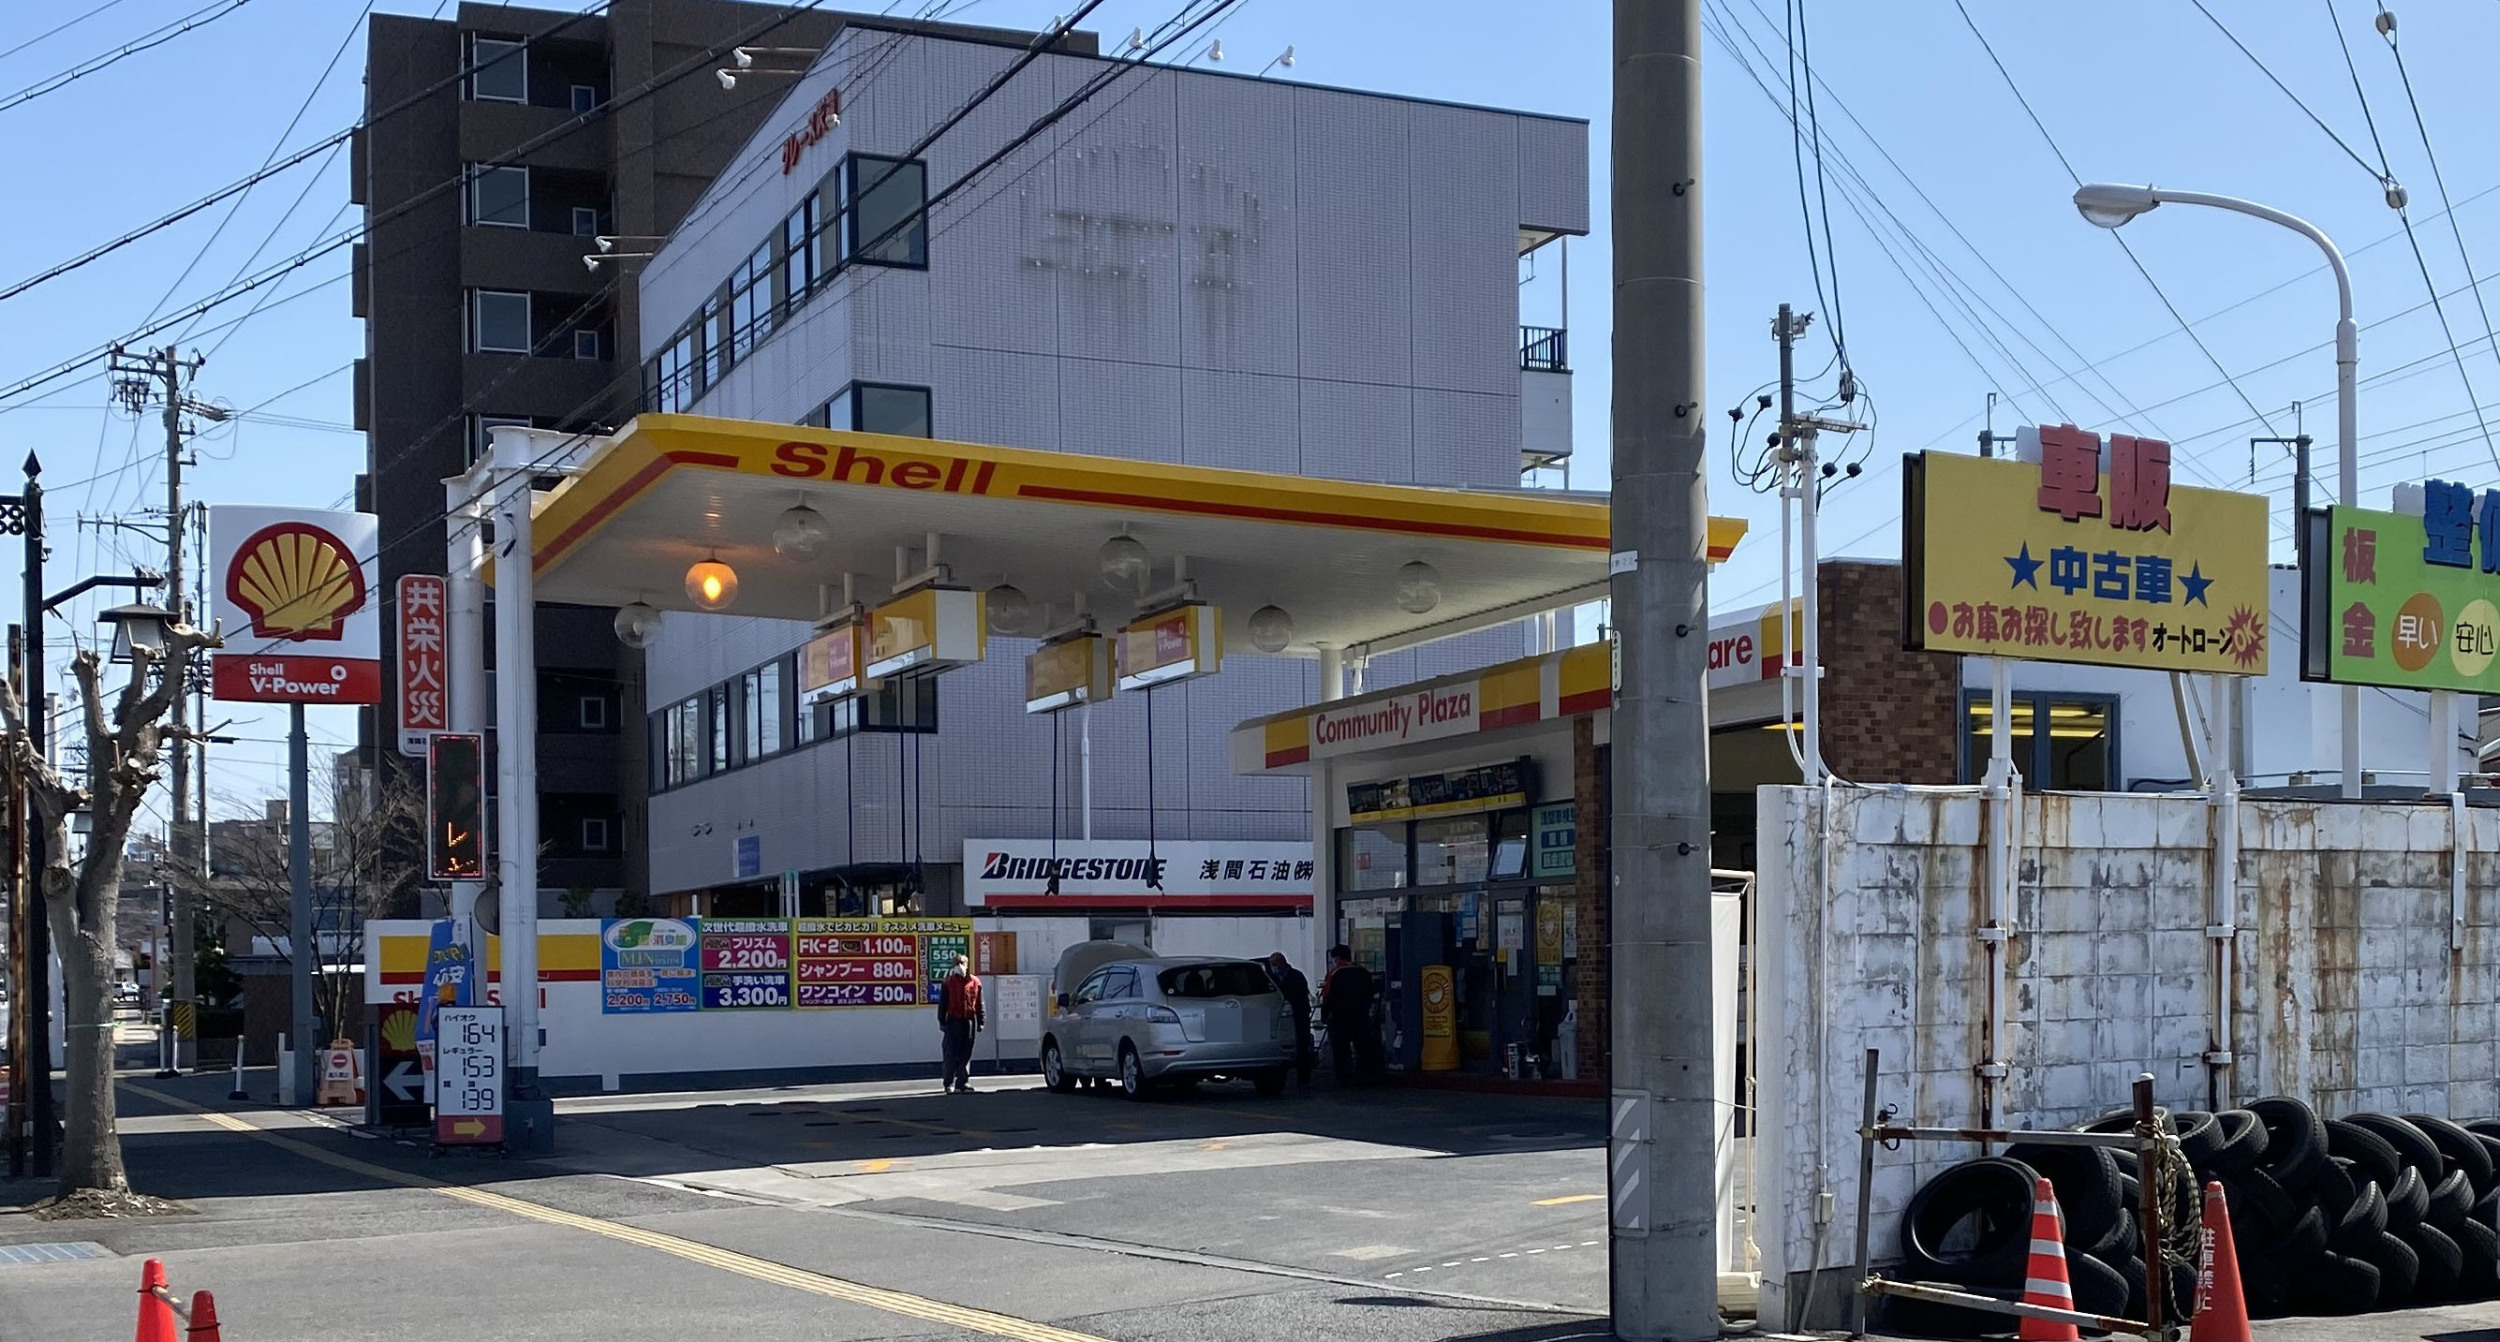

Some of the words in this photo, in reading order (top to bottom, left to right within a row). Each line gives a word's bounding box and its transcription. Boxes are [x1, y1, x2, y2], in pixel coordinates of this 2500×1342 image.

[770, 441, 997, 495] Shell
[2039, 423, 2172, 533] 車販
[2050, 546, 2172, 604] 中古車
[2342, 526, 2377, 659] 板金
[1953, 601, 2149, 653] お車お探し致します
[2152, 622, 2233, 655] オートローン
[2233, 616, 2259, 653] OK
[2398, 615, 2438, 649] 早い
[2455, 621, 2494, 655] 安心
[407, 582, 441, 726] 共栄火災
[249, 662, 284, 676] Shell
[249, 676, 340, 695] V-Power
[1316, 699, 1411, 745] Community
[1418, 689, 1471, 726] Plaza
[980, 852, 1167, 881] BRIDGESTONE
[732, 937, 777, 949] プリズム
[799, 938, 839, 954] FK-2
[863, 938, 912, 955] 1,100円
[718, 949, 787, 969] 2,200円
[799, 962, 865, 978] シャンプー
[872, 962, 913, 979] 880円
[719, 987, 788, 1006] 3,300円
[799, 985, 866, 999] ワンコイン
[872, 986, 913, 1003] 500円
[444, 1014, 477, 1022] ハイオク
[463, 1023, 495, 1045] 164
[443, 1047, 484, 1055] レギュラー
[463, 1055, 495, 1077] 153
[462, 1088, 495, 1111] 139
